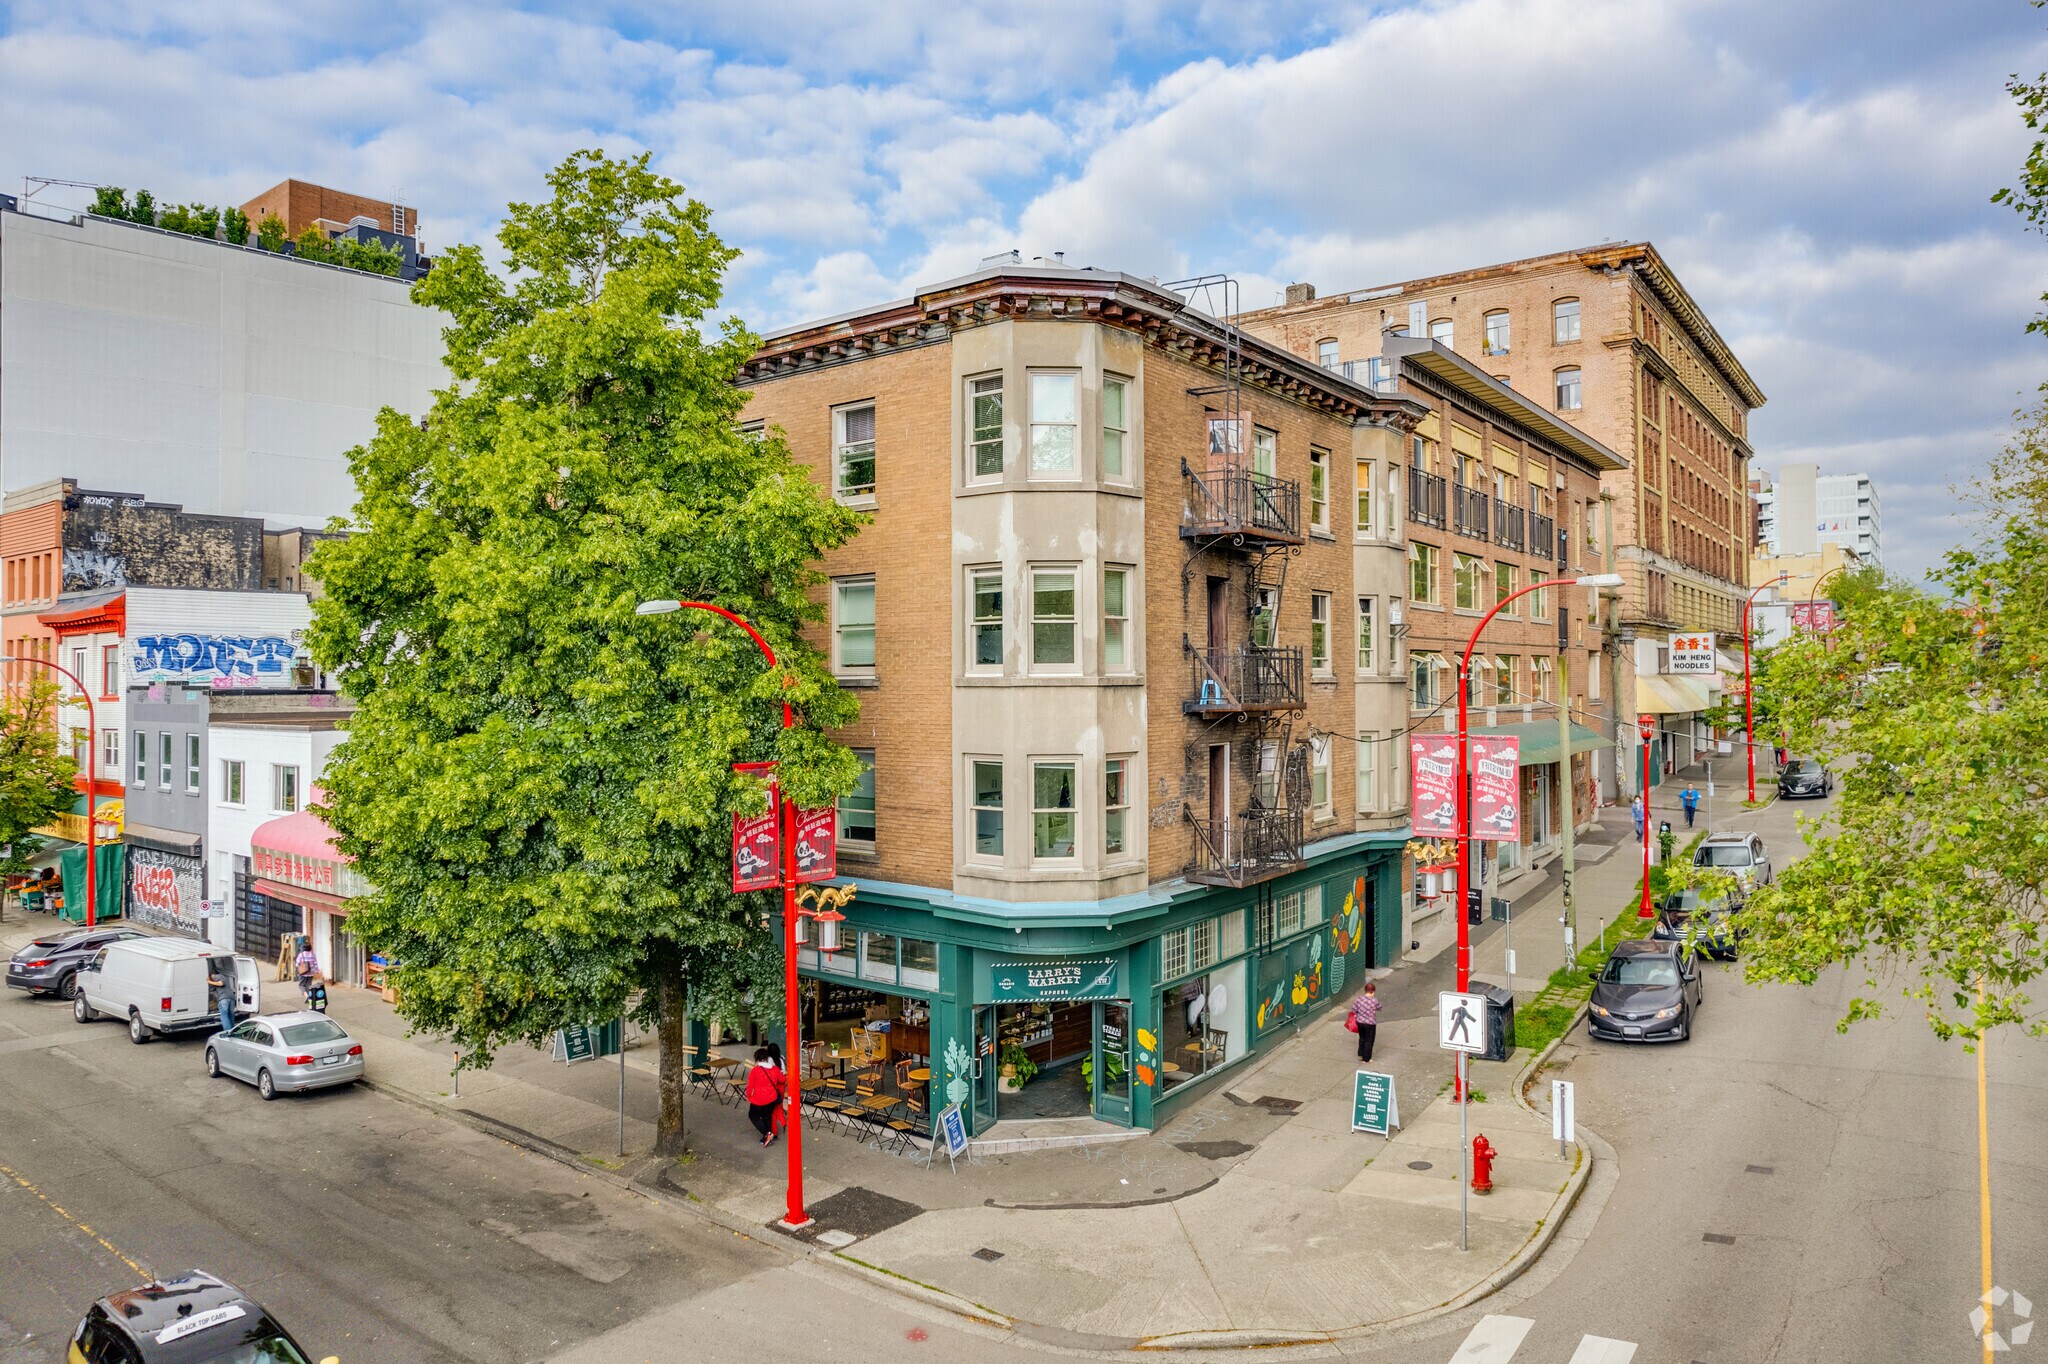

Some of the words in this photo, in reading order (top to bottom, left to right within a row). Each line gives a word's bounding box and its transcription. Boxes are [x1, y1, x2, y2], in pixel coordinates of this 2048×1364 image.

[1028, 967, 1082, 978] LARRY'S
[1028, 976, 1081, 987] MARKET
[177, 1322, 198, 1334] BLACK
[198, 1317, 210, 1326] TOP
[211, 1311, 227, 1322] CABS
